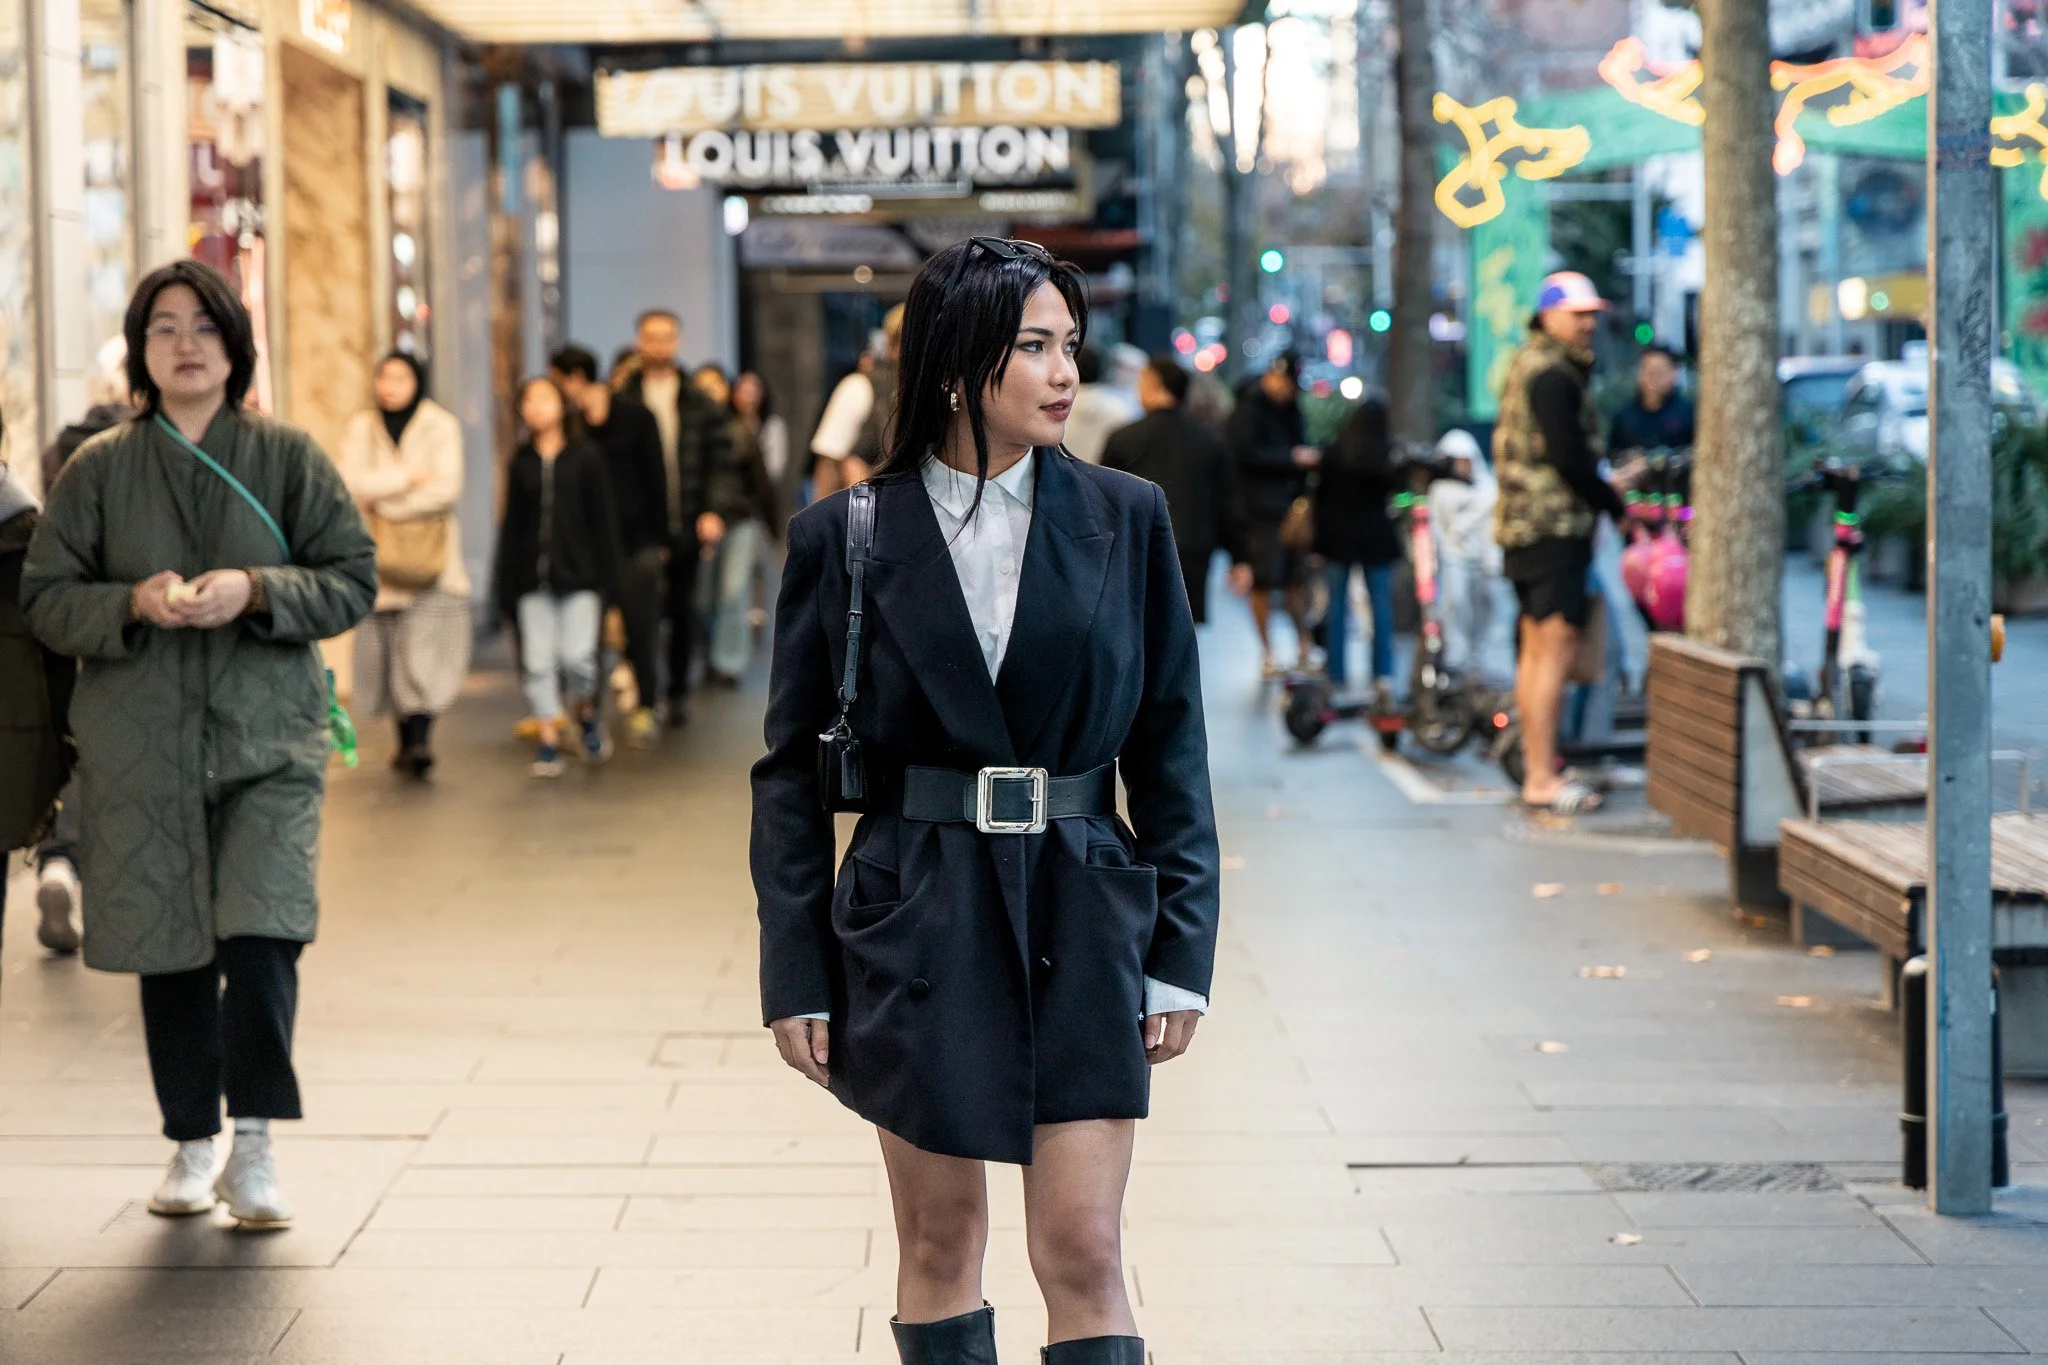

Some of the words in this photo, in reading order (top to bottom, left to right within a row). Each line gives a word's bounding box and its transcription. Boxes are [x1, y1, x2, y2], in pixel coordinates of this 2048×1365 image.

[609, 67, 800, 122] LOUIS
[821, 60, 1103, 121] VUITTON
[664, 129, 823, 180] LOUIS
[835, 125, 1070, 176] VUITTON
